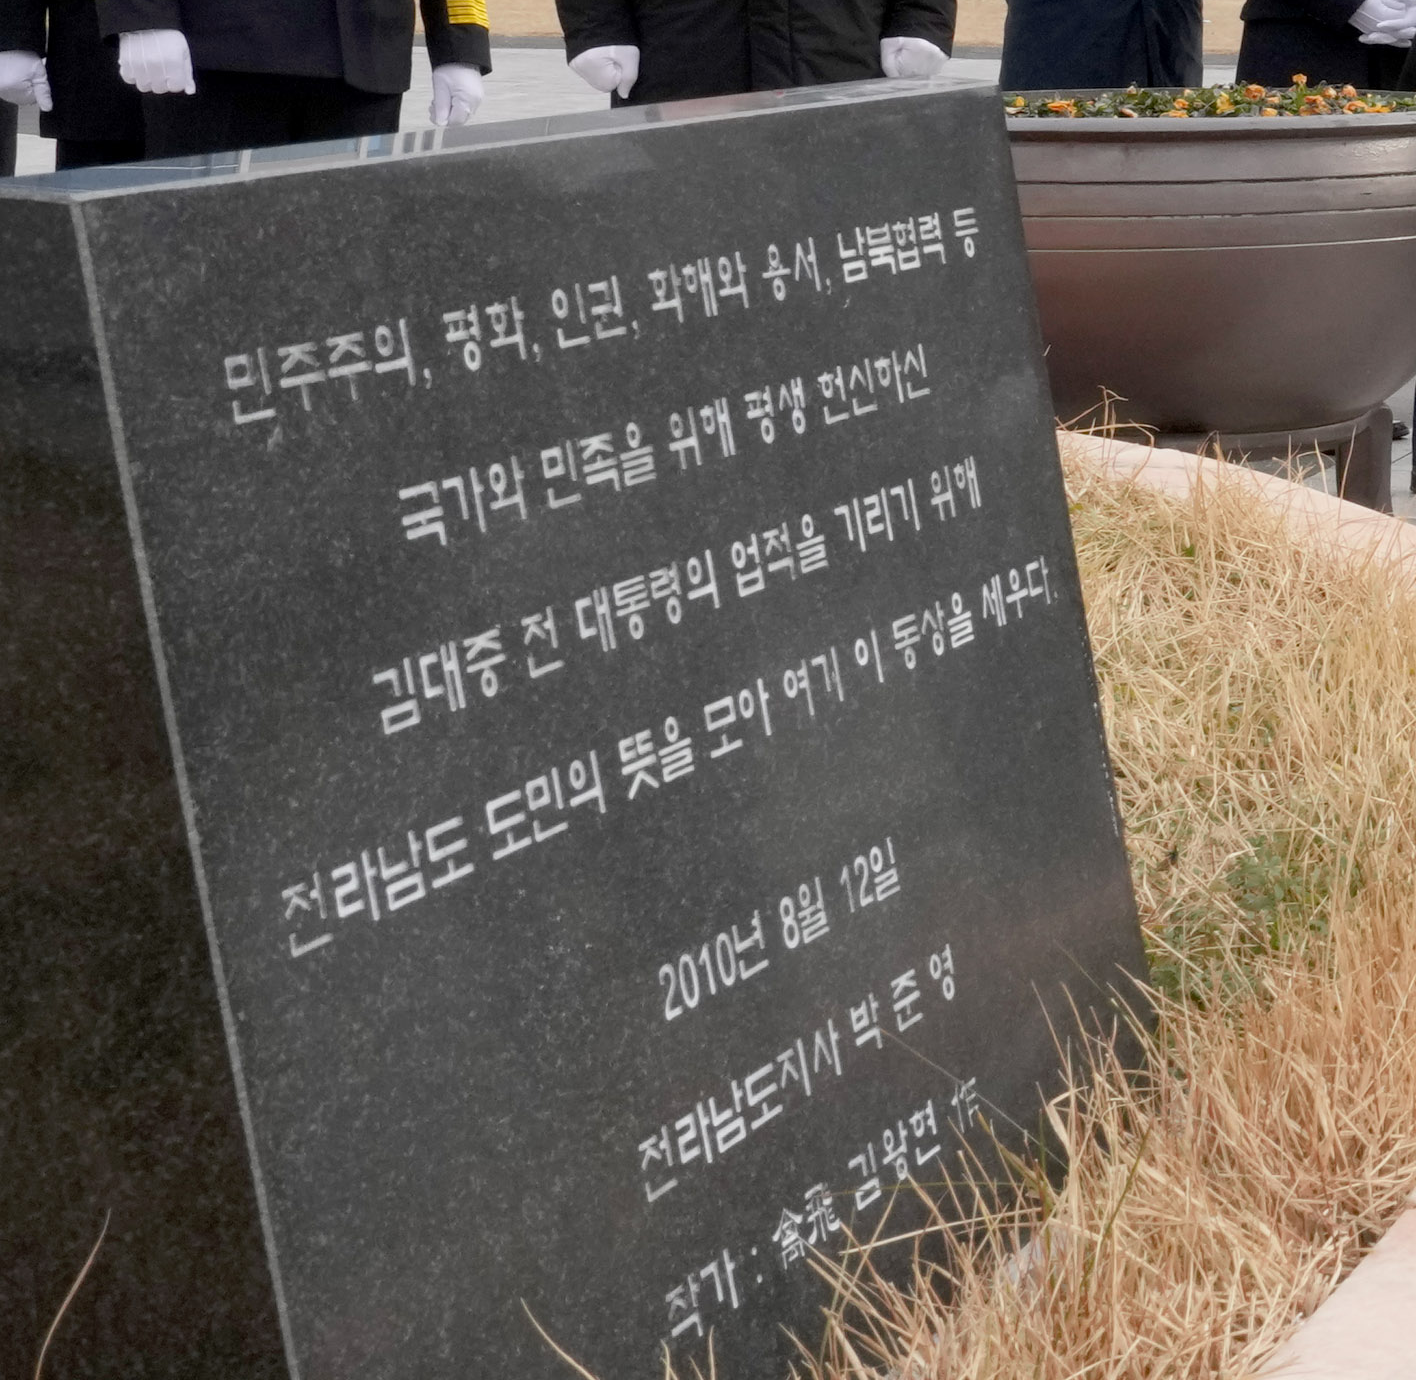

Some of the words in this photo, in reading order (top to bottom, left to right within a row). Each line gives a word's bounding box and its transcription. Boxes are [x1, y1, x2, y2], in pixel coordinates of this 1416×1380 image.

[224, 317, 433, 425] 민주주의,
[442, 295, 542, 372] 평화,
[551, 275, 640, 349] 인권,
[647, 251, 750, 323] 화해와
[762, 236, 833, 302] 용서,
[836, 211, 947, 284] 남북협력
[953, 206, 980, 259] 등
[398, 455, 528, 546] 국가와
[540, 421, 658, 510] 민족을
[669, 396, 737, 470] 위해
[743, 376, 807, 445] 평생
[817, 342, 931, 425] 헌신하신
[371, 626, 506, 736] 김대중
[520, 605, 566, 680] 전
[573, 548, 721, 653] 대통령의
[730, 513, 830, 598] 업적을
[833, 477, 921, 553] 기리기
[930, 455, 982, 522] 위해
[281, 815, 475, 959] 전라남도
[484, 749, 607, 861] 도민의
[617, 715, 696, 800] 뜻을
[703, 677, 772, 759] 모아
[782, 645, 845, 717] 여기
[854, 628, 885, 684] 이
[891, 591, 976, 670] 동상을
[981, 555, 1059, 627] 세우다.
[658, 909, 770, 1021] 2010년
[779, 876, 831, 950] 8월
[840, 836, 901, 913] 12일
[638, 1018, 843, 1203] 전라남도지사
[665, 1248, 739, 1338] 작가
[847, 1099, 942, 1212] 김왕현
